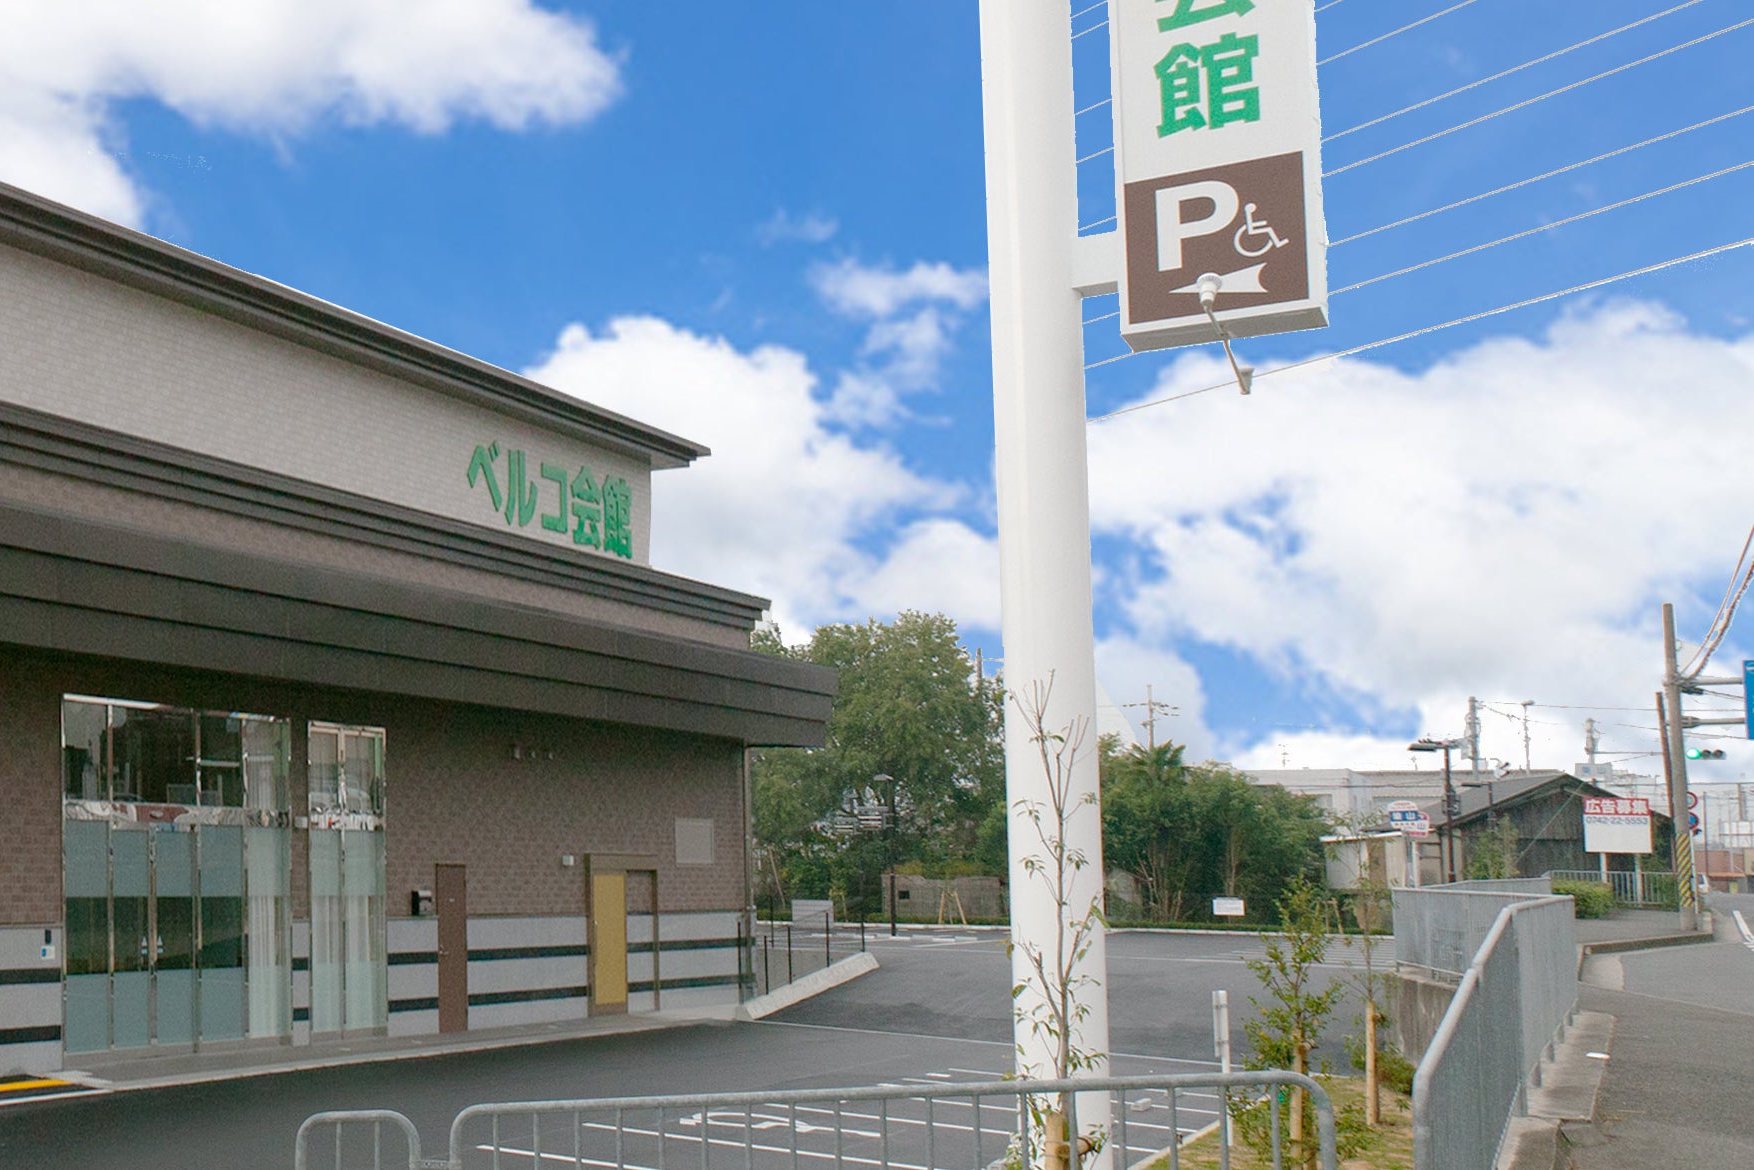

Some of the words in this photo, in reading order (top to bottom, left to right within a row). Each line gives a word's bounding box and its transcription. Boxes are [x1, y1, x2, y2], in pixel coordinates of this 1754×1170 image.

[1155, 180, 1239, 272] P
[466, 440, 633, 559] ベルコ会館
